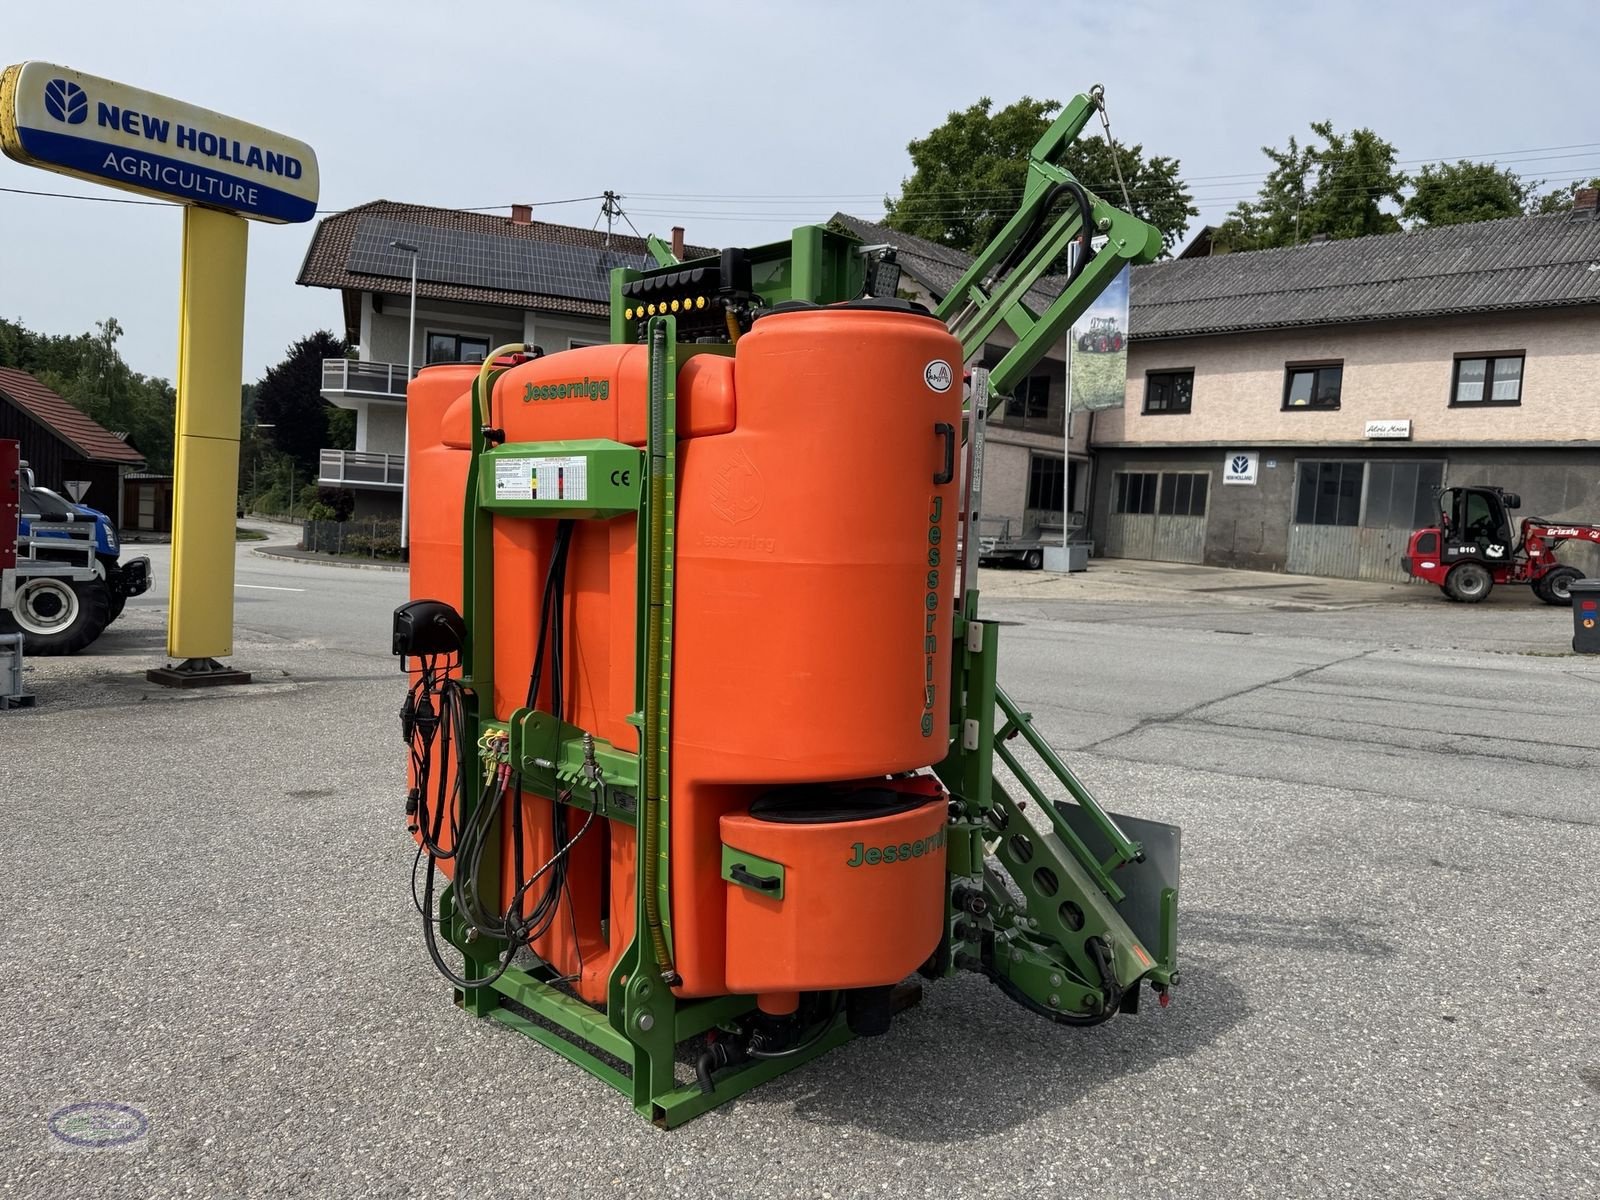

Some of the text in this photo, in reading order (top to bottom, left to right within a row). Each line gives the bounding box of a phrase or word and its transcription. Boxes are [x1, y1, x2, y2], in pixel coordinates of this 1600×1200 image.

[98, 102, 302, 181] NEW HOLLAND
[103, 151, 258, 206] AGRICULTURE
[524, 376, 610, 403] Jessernigg
[610, 470, 630, 487] CE
[1546, 526, 1579, 536] Grizzly
[1459, 546, 1476, 554] 810
